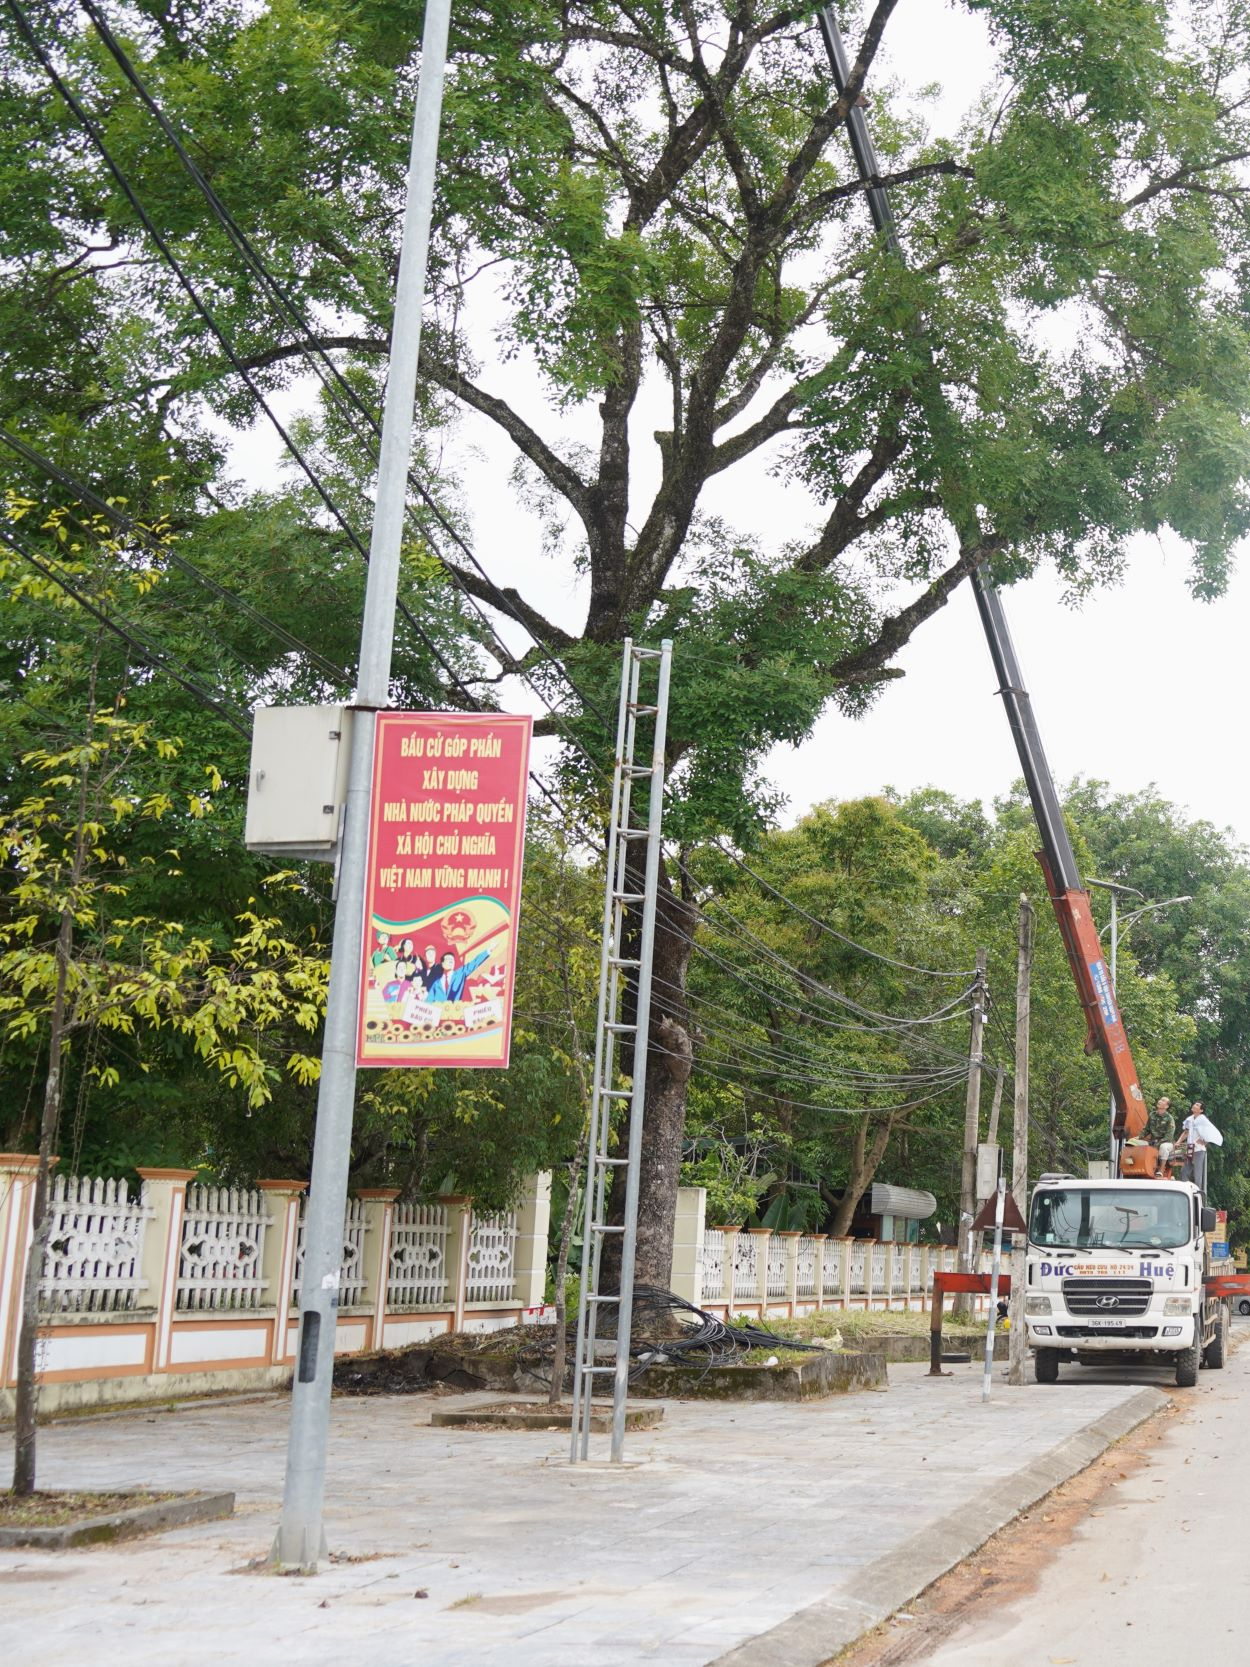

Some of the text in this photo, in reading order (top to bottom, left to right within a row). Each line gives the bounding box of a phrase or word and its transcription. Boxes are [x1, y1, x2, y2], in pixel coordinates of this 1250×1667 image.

[400, 731, 502, 758] BẦU CỬ GÓP PHẦN
[422, 766, 479, 794] XÂY DỰNG
[384, 797, 514, 825] NHÀ NƯỚC PHÁP QUYỀN
[396, 829, 496, 859] XÃ HỘI CHỦ NGHĨA
[380, 864, 404, 892] VIỆT
[405, 868, 432, 888] NAM
[434, 864, 465, 888] VỮNG
[467, 868, 502, 893] MẠNH
[1040, 1262, 1074, 1277] Đức
[1139, 1262, 1175, 1280] Huệ
